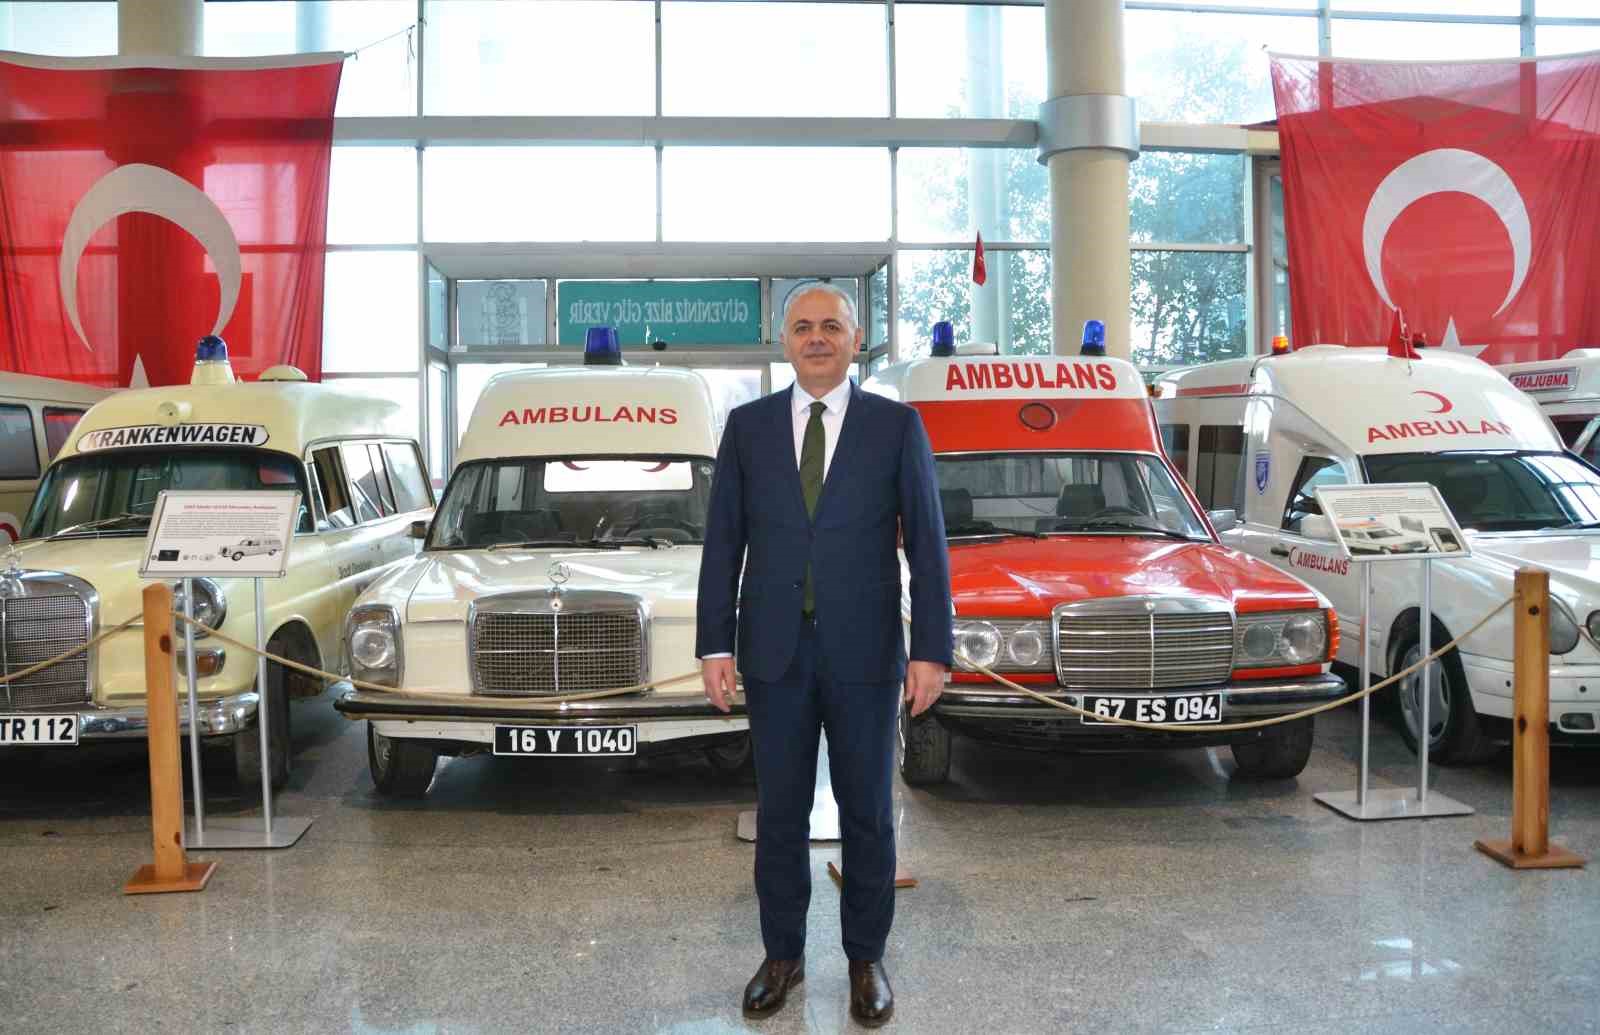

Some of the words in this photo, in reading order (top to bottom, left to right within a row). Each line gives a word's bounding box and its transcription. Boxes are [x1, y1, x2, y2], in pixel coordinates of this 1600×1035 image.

[946, 363, 1117, 391] AMBULANS
[498, 406, 678, 427] AMBULANS
[88, 425, 257, 449] KRANKENWAGEN
[1367, 420, 1512, 443] AMBULAN
[1296, 552, 1349, 576] AMBULANS
[1094, 699, 1126, 721] 67
[1135, 699, 1167, 722] ES
[1174, 696, 1217, 721] 094
[509, 728, 536, 752] 16
[546, 730, 561, 753] Y
[574, 728, 632, 753] 1040
